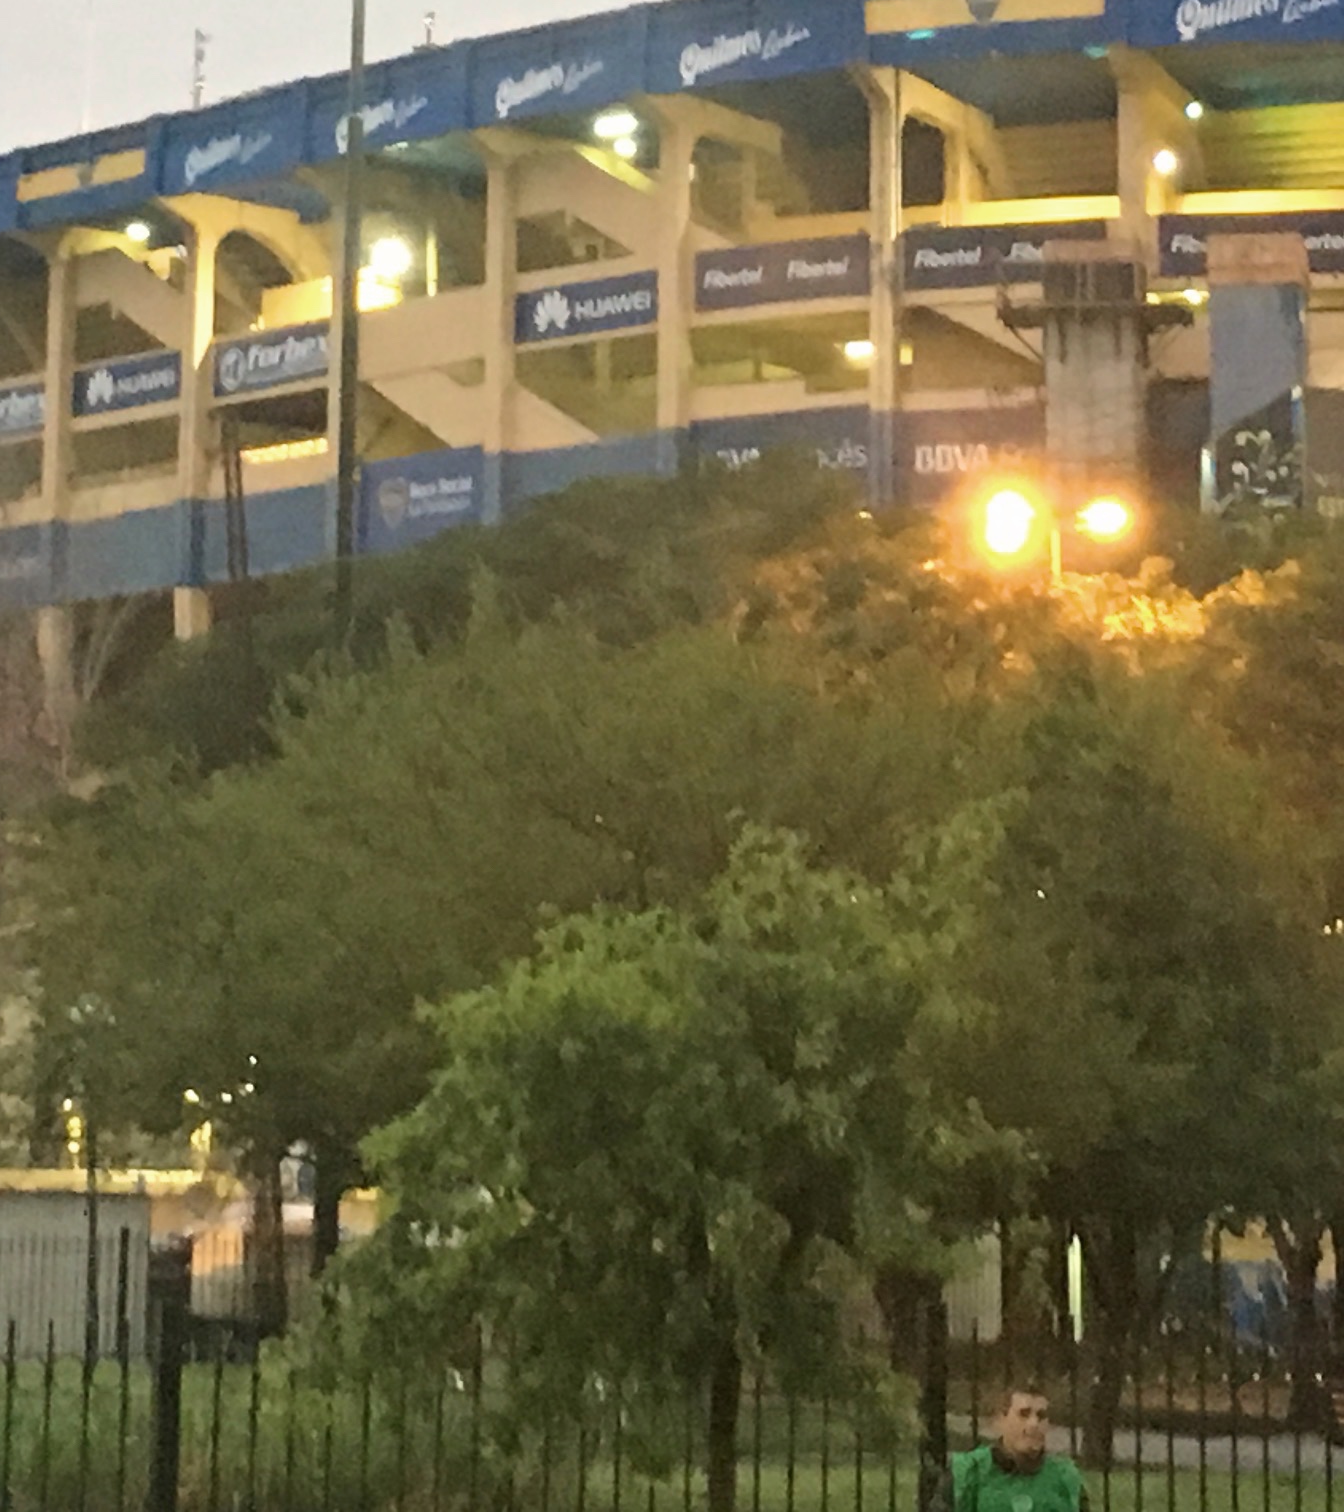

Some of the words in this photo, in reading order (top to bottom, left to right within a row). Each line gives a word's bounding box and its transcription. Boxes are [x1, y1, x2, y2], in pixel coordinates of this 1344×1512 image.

[679, 30, 762, 87] Quilmes
[786, 256, 851, 280] Fibertel
[574, 290, 652, 321] HUAWEI
[914, 443, 989, 474] BBVA
